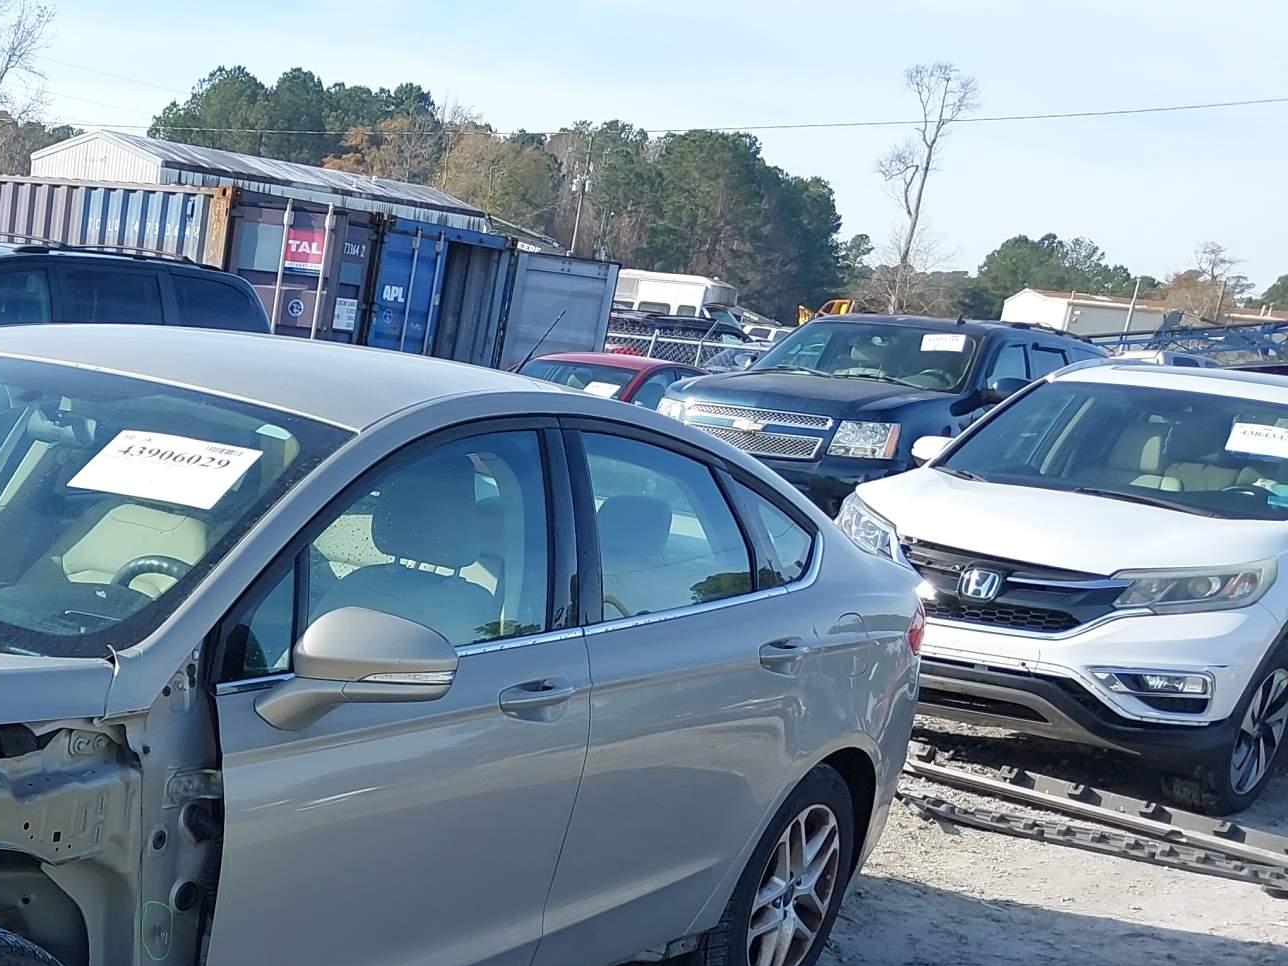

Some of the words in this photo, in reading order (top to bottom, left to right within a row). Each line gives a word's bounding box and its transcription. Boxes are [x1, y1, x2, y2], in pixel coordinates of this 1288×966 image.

[288, 239, 322, 255] TAL
[516, 241, 542, 253] EERE
[382, 284, 405, 303] APL
[118, 444, 231, 469] 43906029
